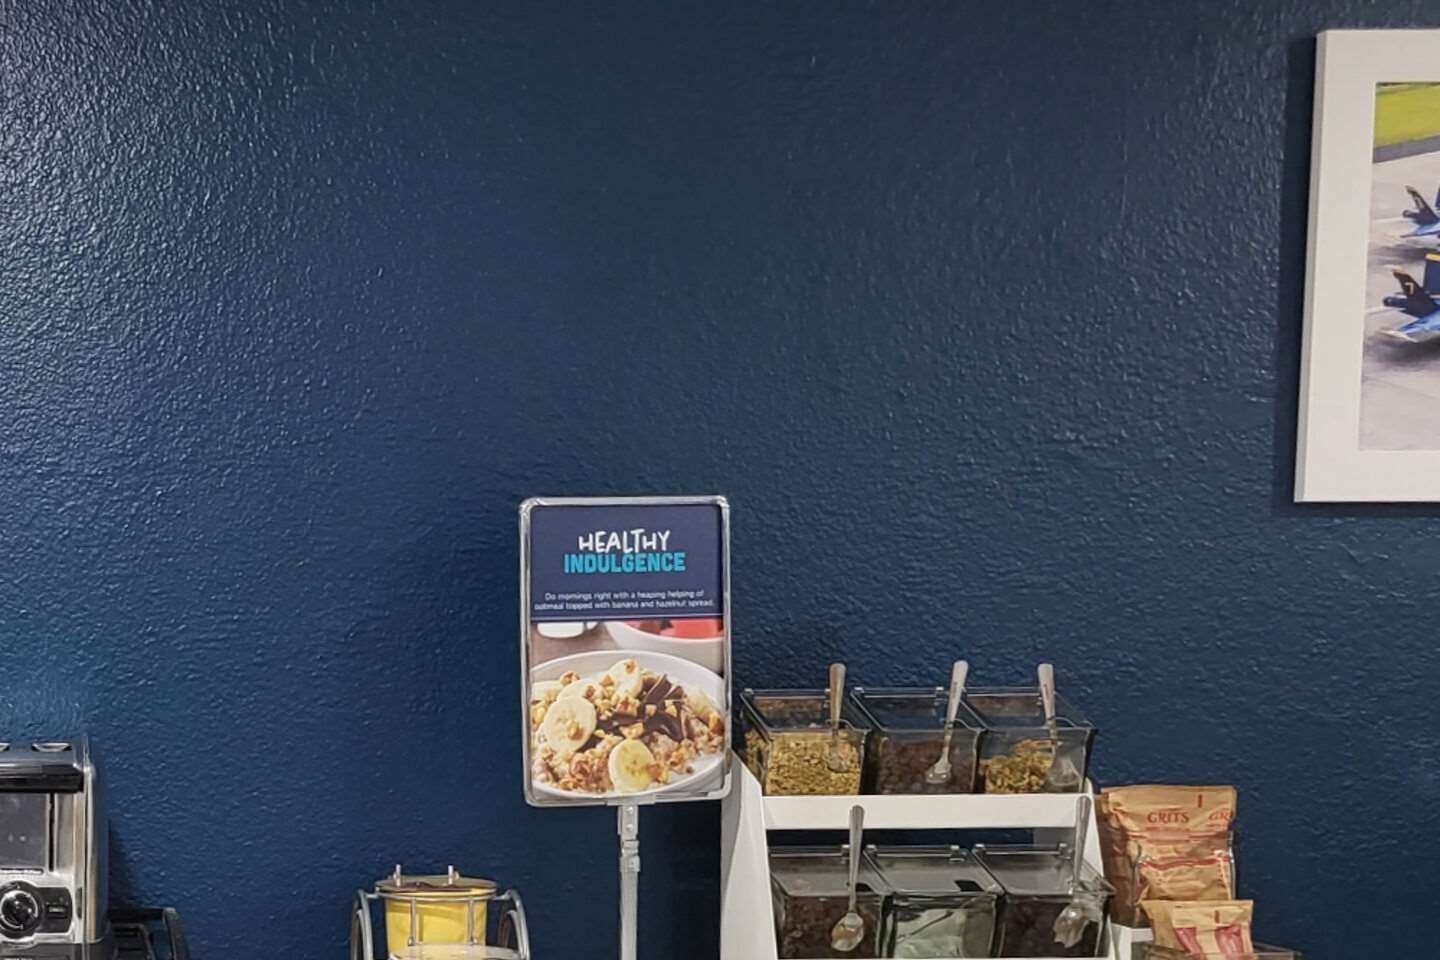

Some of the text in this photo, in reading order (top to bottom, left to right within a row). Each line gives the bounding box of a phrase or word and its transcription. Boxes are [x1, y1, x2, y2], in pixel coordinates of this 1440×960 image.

[578, 528, 671, 553] HEALTHY
[563, 552, 686, 573] INDULGENCE
[545, 592, 556, 601] Do
[558, 592, 592, 602] mornings
[594, 591, 611, 601] right
[613, 591, 629, 599] with
[637, 591, 666, 600] heaping
[667, 590, 695, 599] helping
[696, 589, 705, 597] of
[534, 602, 564, 610] oatmeal
[566, 602, 593, 611] topped
[594, 601, 611, 609] with
[612, 600, 639, 609] banana
[640, 600, 654, 608] and
[656, 599, 686, 608] hazelnut
[1147, 811, 1190, 824] GRITS
